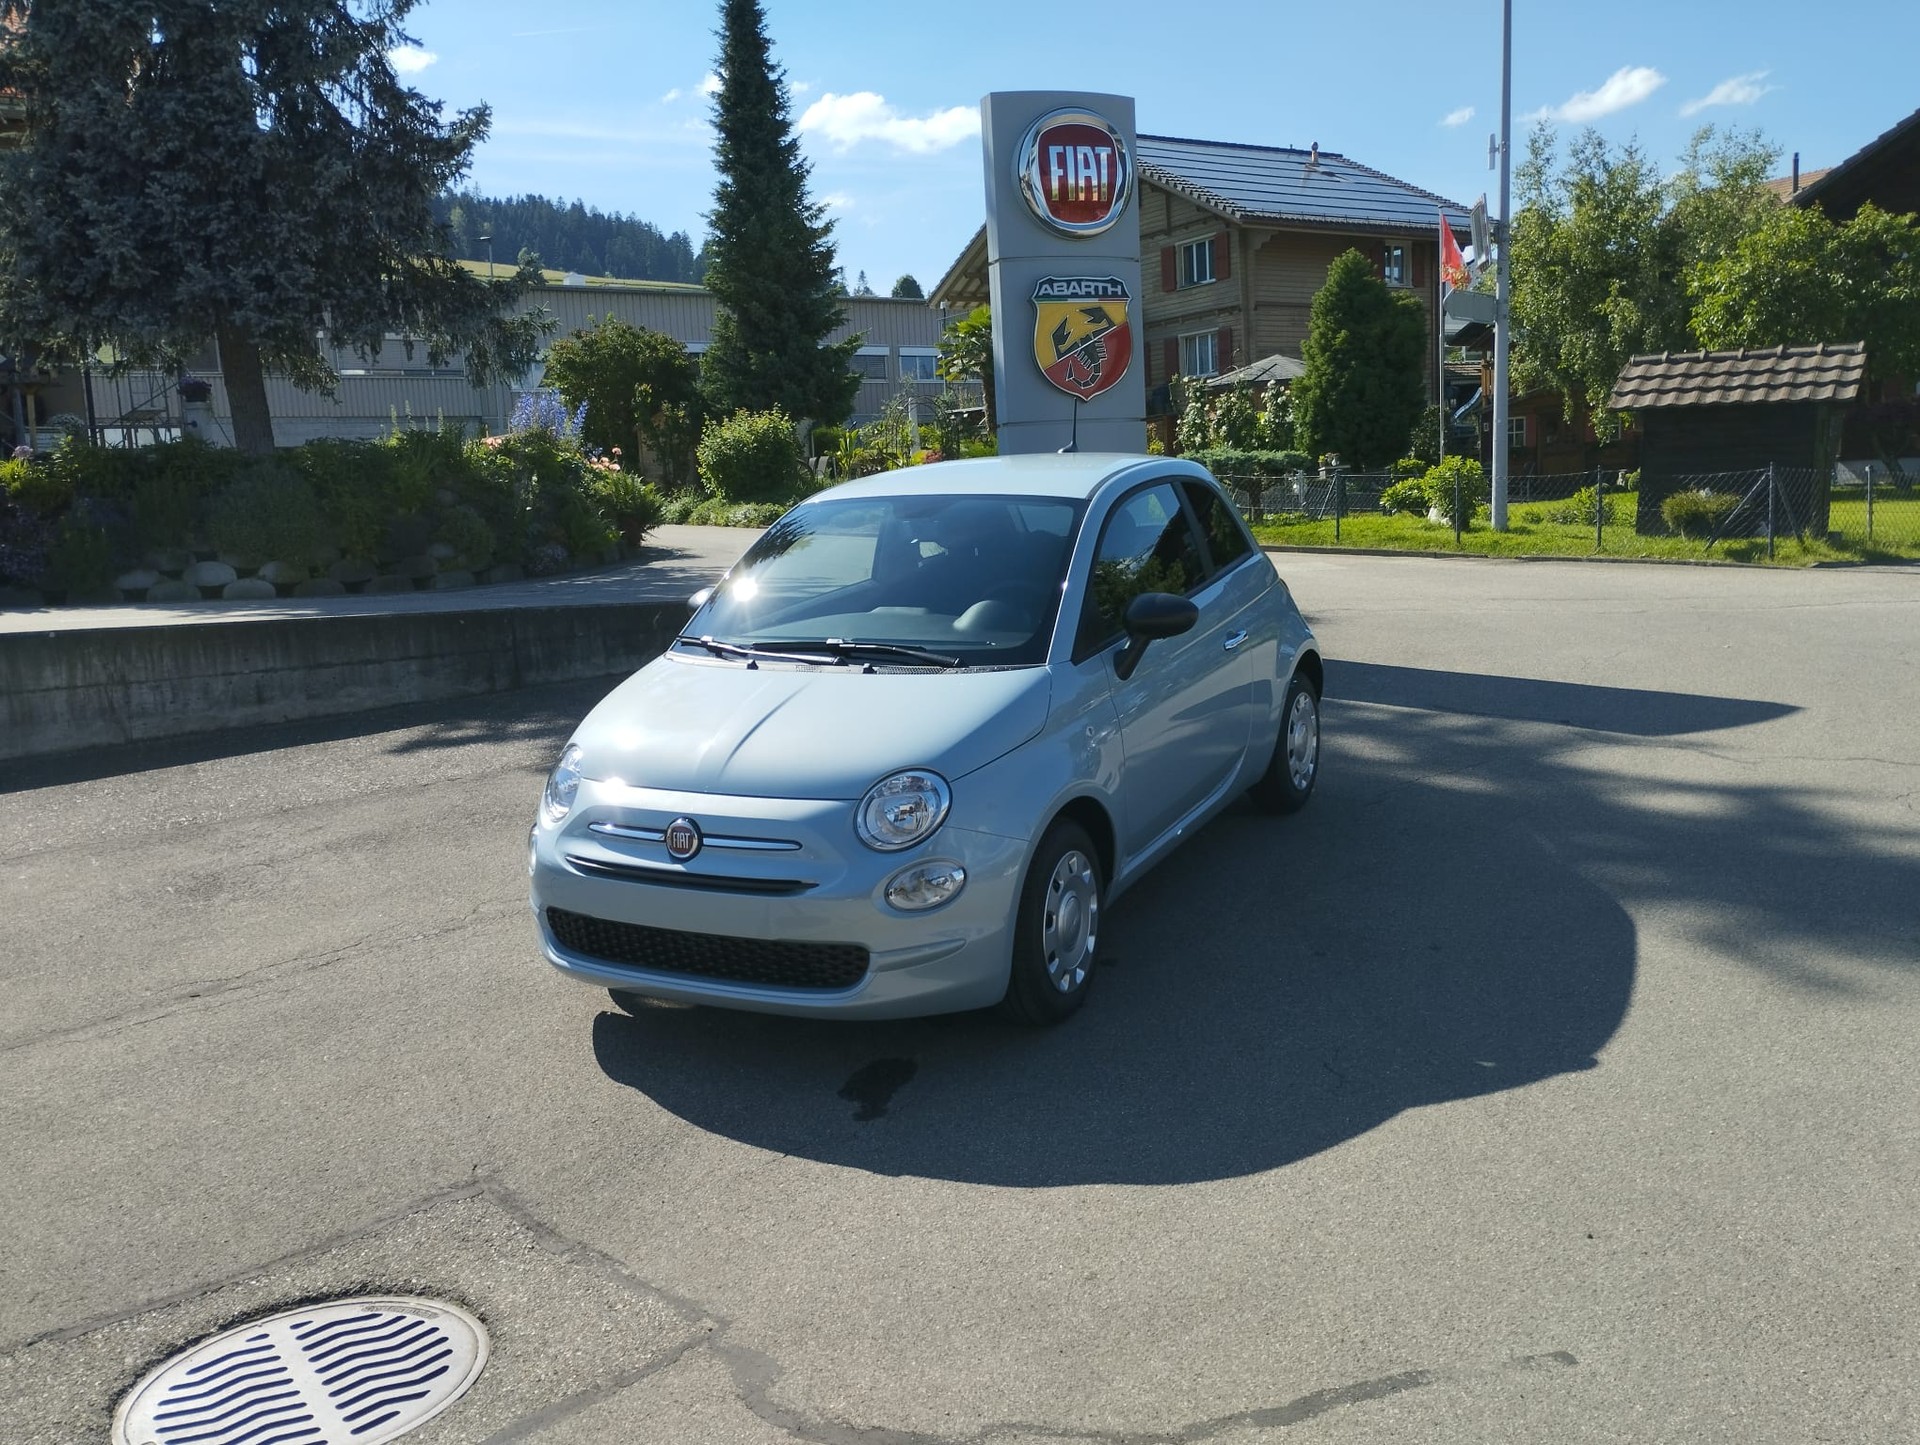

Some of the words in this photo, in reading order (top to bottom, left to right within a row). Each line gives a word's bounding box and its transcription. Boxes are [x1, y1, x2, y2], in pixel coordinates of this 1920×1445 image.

[1048, 145, 1112, 202] FIAT
[1038, 280, 1122, 296] ABARTH
[673, 832, 690, 849] FIAT
